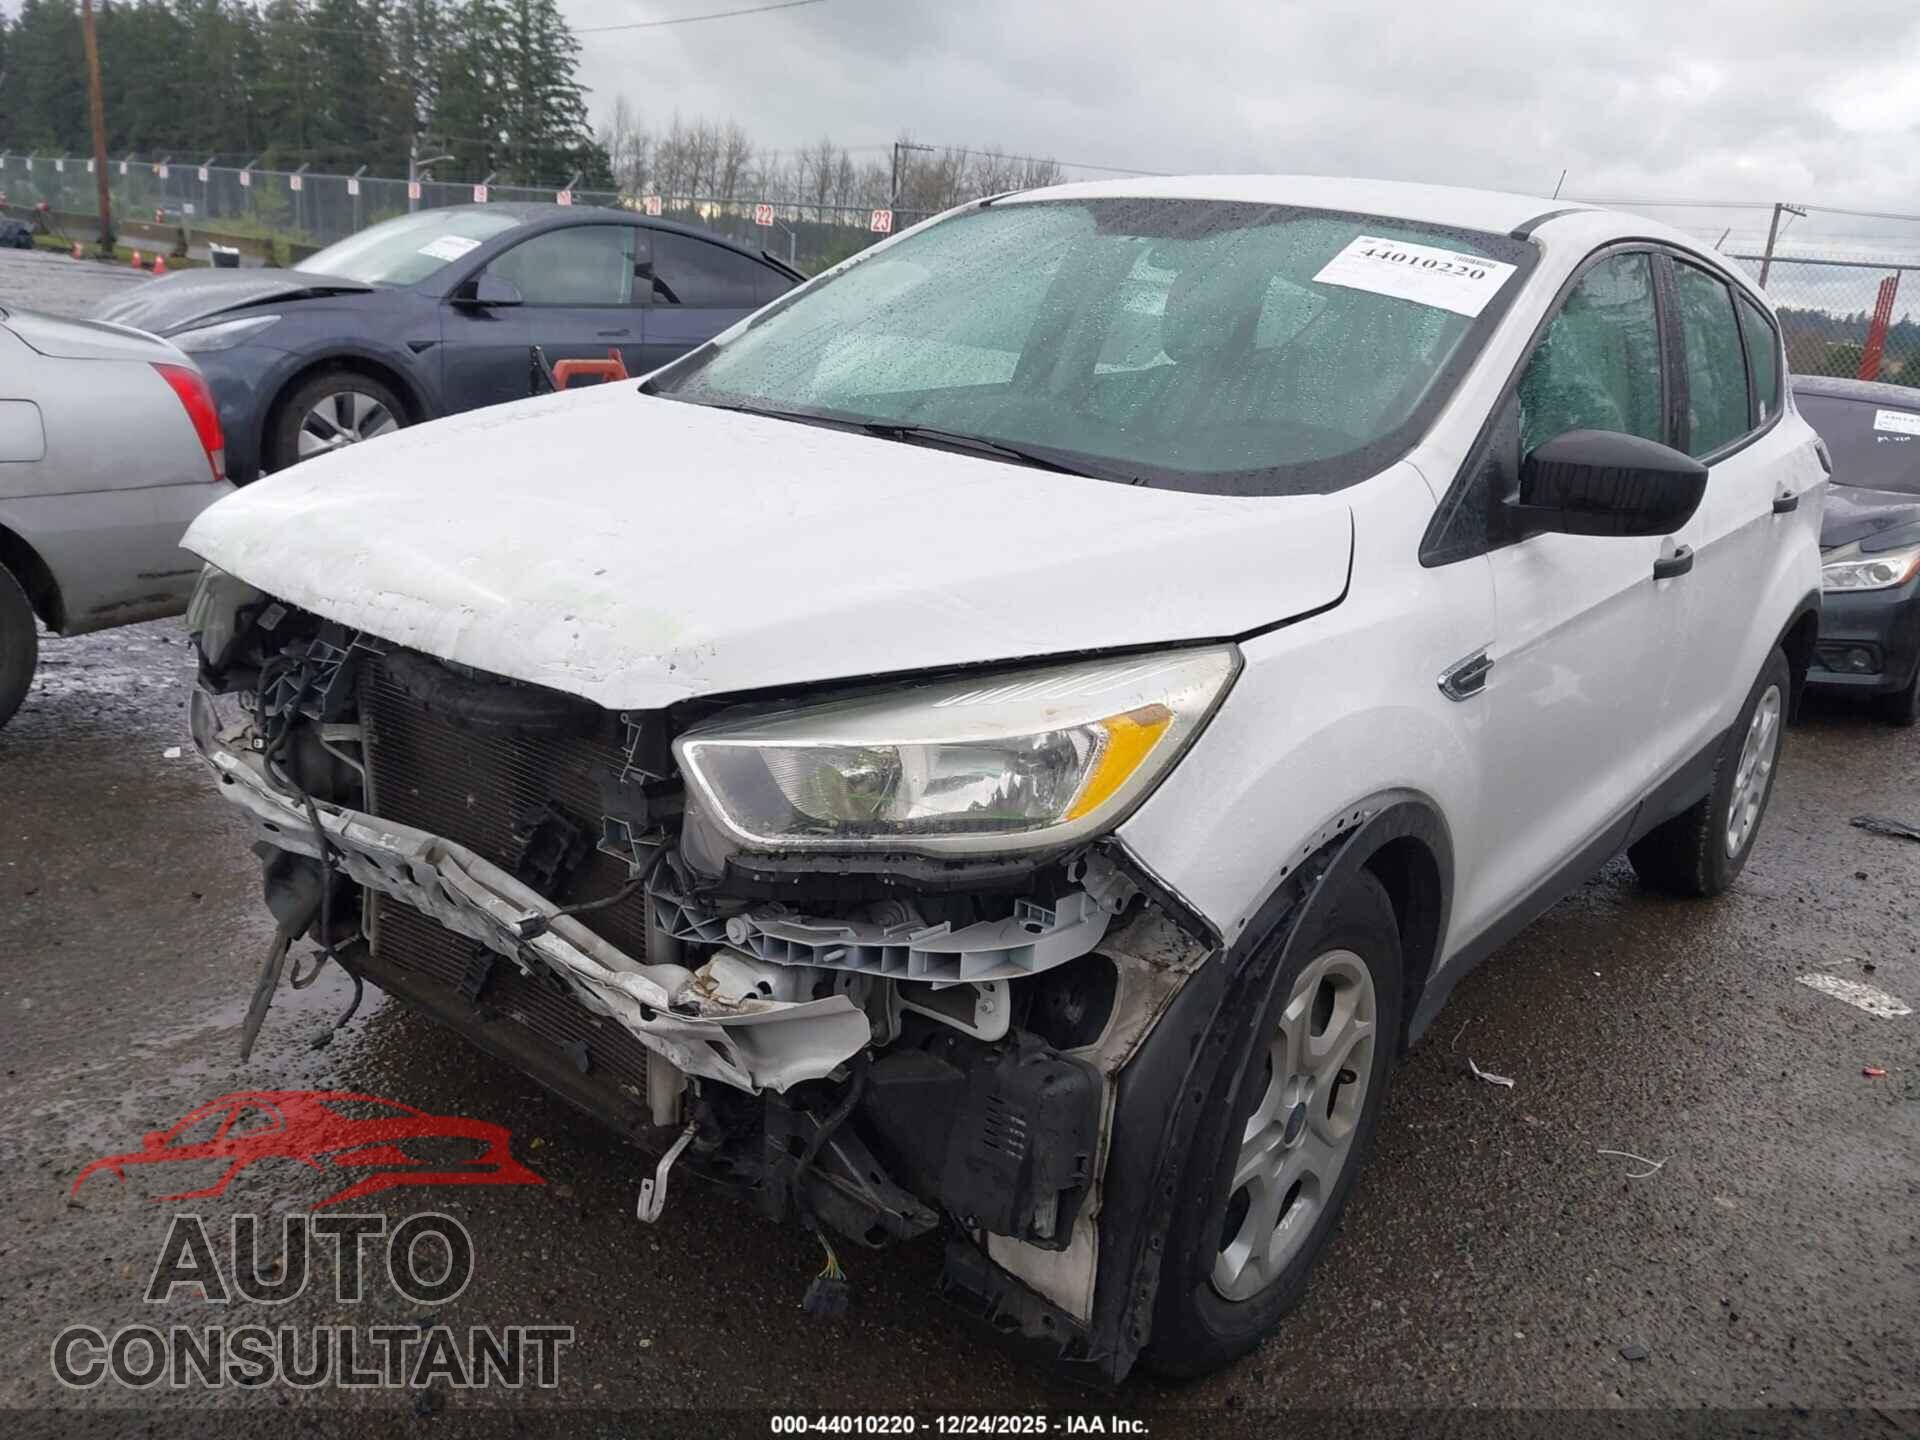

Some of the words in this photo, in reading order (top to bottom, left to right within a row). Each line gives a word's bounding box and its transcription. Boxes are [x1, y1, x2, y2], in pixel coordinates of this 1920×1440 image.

[758, 206, 772, 224] 22
[873, 212, 890, 230] 23
[1360, 249, 1485, 280] 44010220
